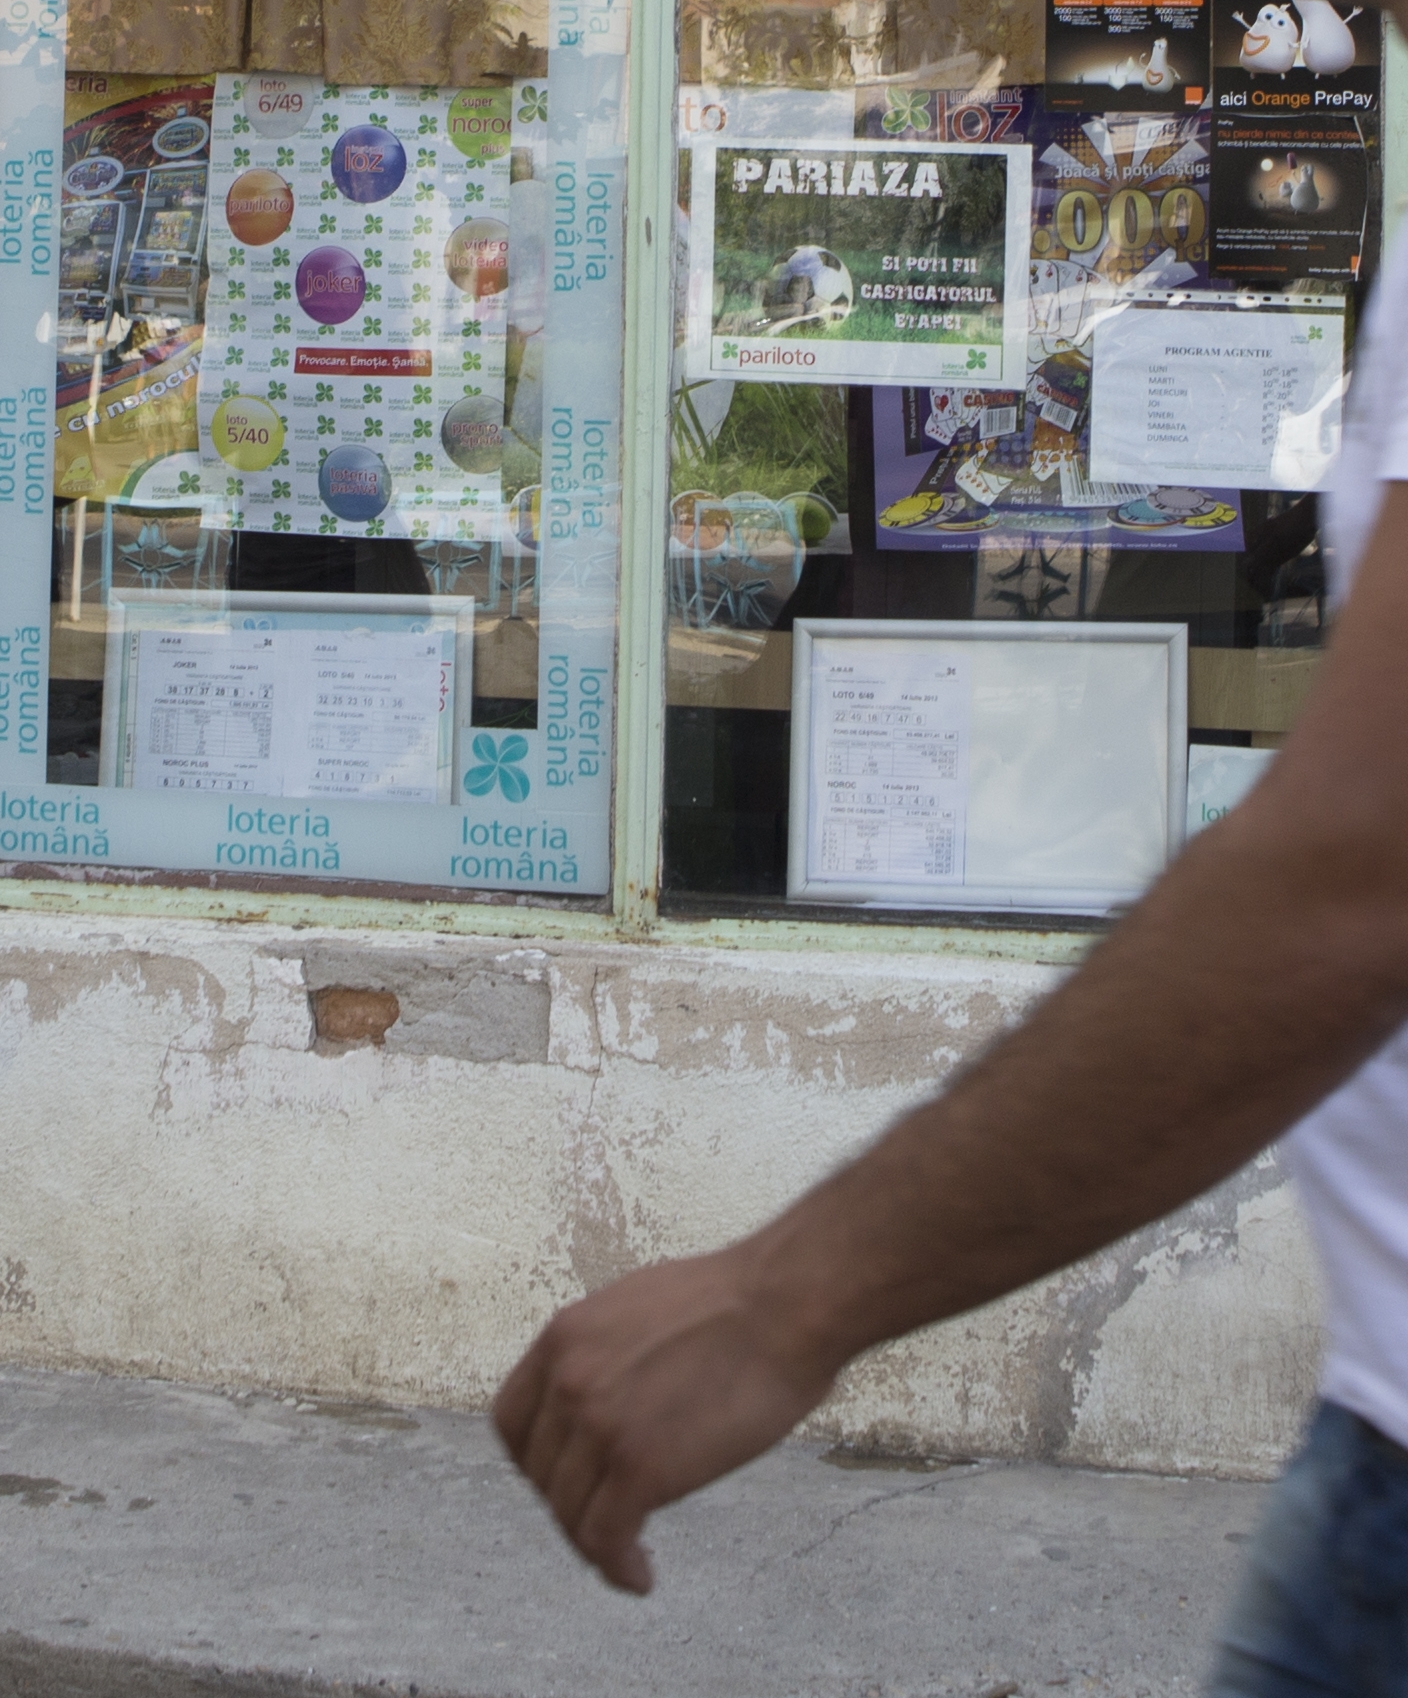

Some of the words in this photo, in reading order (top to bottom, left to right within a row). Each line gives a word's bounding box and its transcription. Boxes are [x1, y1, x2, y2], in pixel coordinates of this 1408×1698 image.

[260, 80, 286, 92] loto
[258, 94, 303, 113] 6/49
[462, 97, 493, 108] super
[949, 87, 1023, 103] instant
[1220, 91, 1247, 106] aici
[1252, 91, 1310, 108] Orange
[1314, 90, 1373, 108] PrePay
[936, 92, 1024, 144] loz
[1233, 129, 1263, 140] pierde
[481, 144, 505, 155] plus
[345, 146, 384, 172] loz
[732, 157, 943, 198] PARIAZA
[1055, 164, 1100, 179] Joacă
[29, 148, 55, 276] română
[229, 197, 290, 217] pariloto
[553, 160, 582, 294] română
[585, 171, 615, 283] loteria
[464, 238, 508, 251] video
[453, 255, 506, 268] loteria
[905, 257, 947, 273] POTI
[305, 269, 362, 298] joker
[860, 283, 997, 303] CASTIGATORUL
[894, 313, 962, 331] ETAPEI
[299, 354, 349, 366] Provocare.
[739, 346, 816, 368] pariloto
[1165, 346, 1221, 357] PROGRAM
[1223, 347, 1273, 358] AGENTIE
[1148, 365, 1168, 373] LUNI
[1148, 376, 1175, 385] MARTI
[1148, 388, 1188, 397] MIERCURI
[1148, 400, 1160, 408] JOI
[226, 415, 248, 425] loto
[1148, 411, 1174, 420] VINERI
[227, 427, 269, 444] 5/40
[452, 420, 498, 437] prono
[1147, 423, 1186, 432] SAMBATA
[1147, 434, 1189, 443] DUMINICA
[21, 386, 47, 516] română
[330, 467, 378, 482] loteria
[550, 405, 579, 540] română
[582, 417, 611, 530] loteria
[17, 624, 42, 756] română
[833, 691, 855, 699] LOTO
[546, 654, 575, 788] română
[579, 667, 608, 780] loteria
[163, 759, 188, 767] NOROC
[190, 760, 209, 768] PLUS
[318, 758, 342, 766] SUPER
[828, 781, 856, 789] NOROC
[0, 792, 100, 825] loteria
[226, 804, 331, 838] loteria
[461, 816, 569, 850] loteria
[215, 838, 341, 872] română
[449, 851, 579, 885] română
